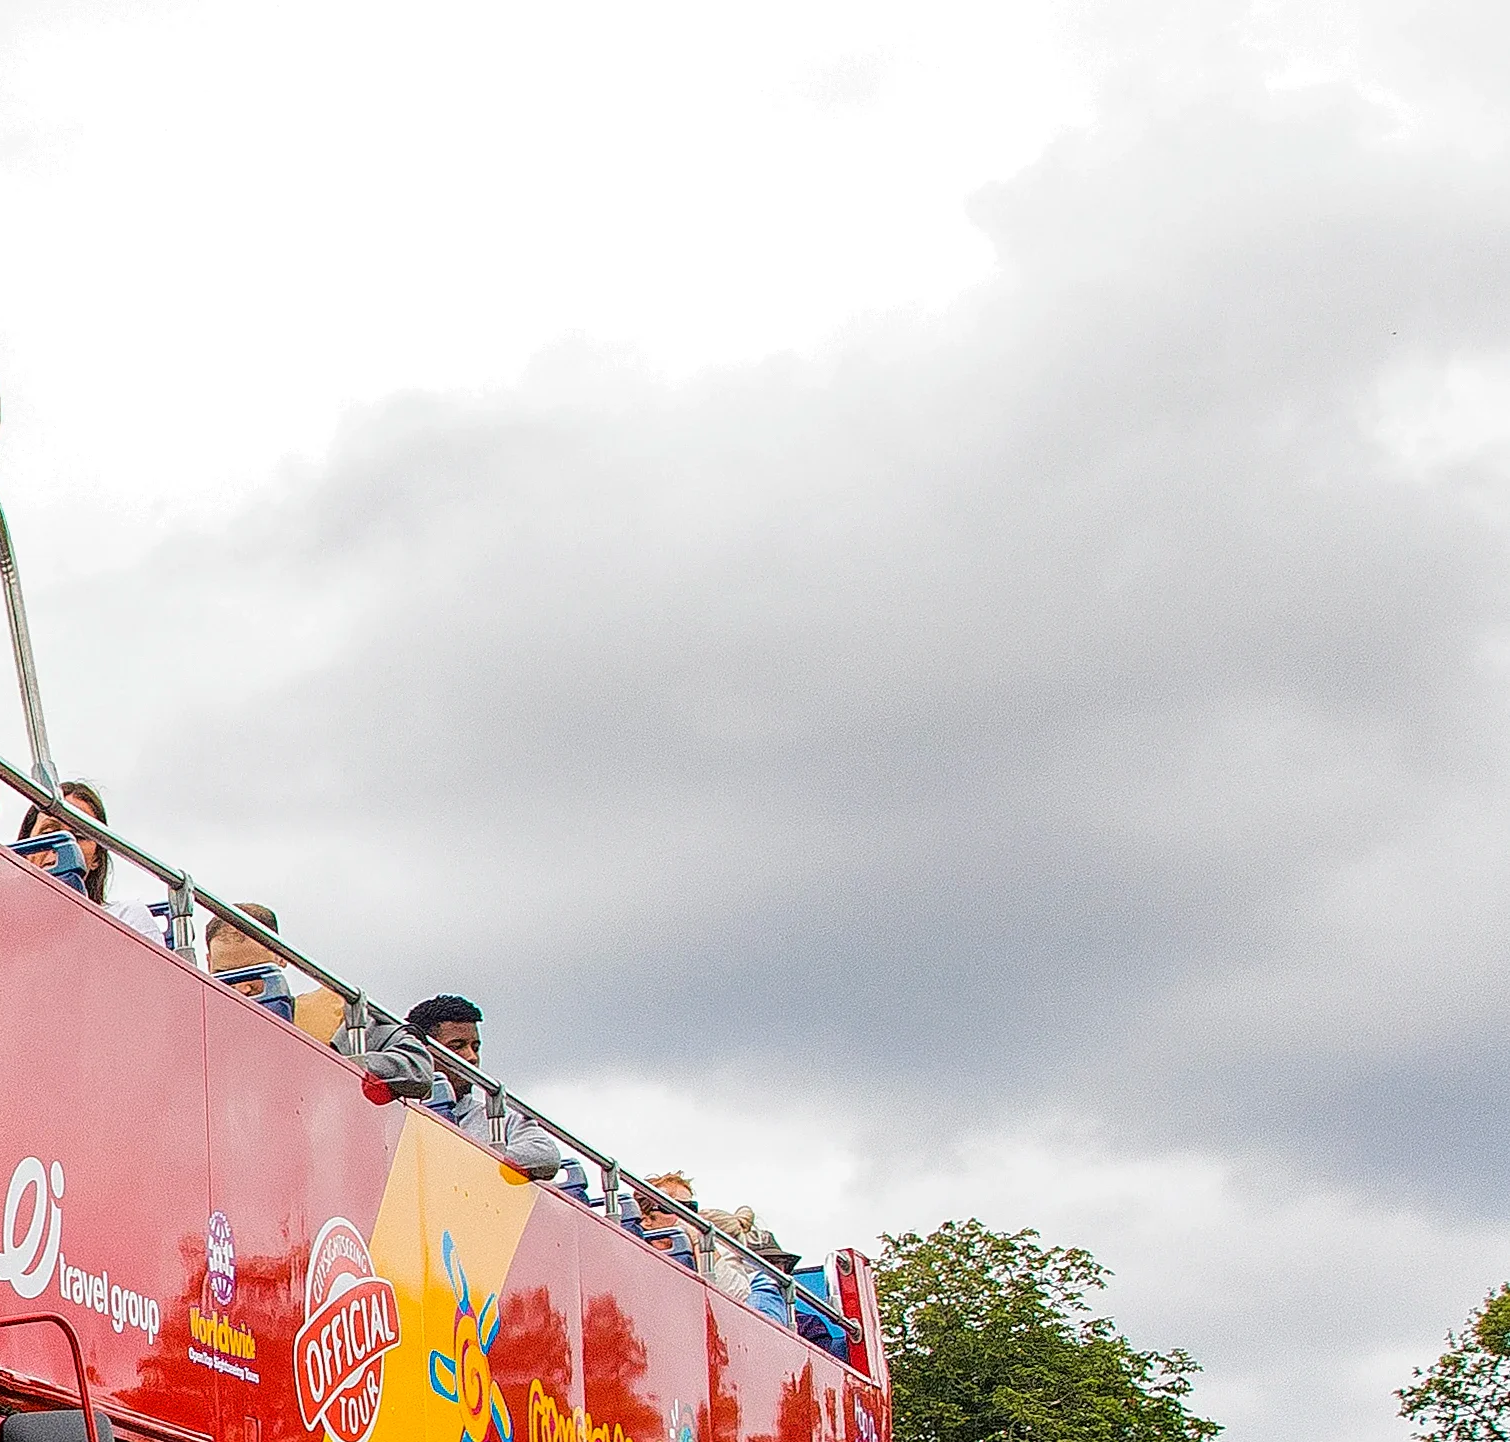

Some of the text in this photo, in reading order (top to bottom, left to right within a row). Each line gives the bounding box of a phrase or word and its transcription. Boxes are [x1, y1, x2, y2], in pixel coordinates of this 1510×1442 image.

[59, 1252, 160, 1345] travel group
[312, 1234, 367, 1304] CITYSIGHTSEEING
[189, 1305, 256, 1361] Worldwide
[305, 1289, 396, 1403] OFFICIAL
[339, 1370, 379, 1435] TOUR
